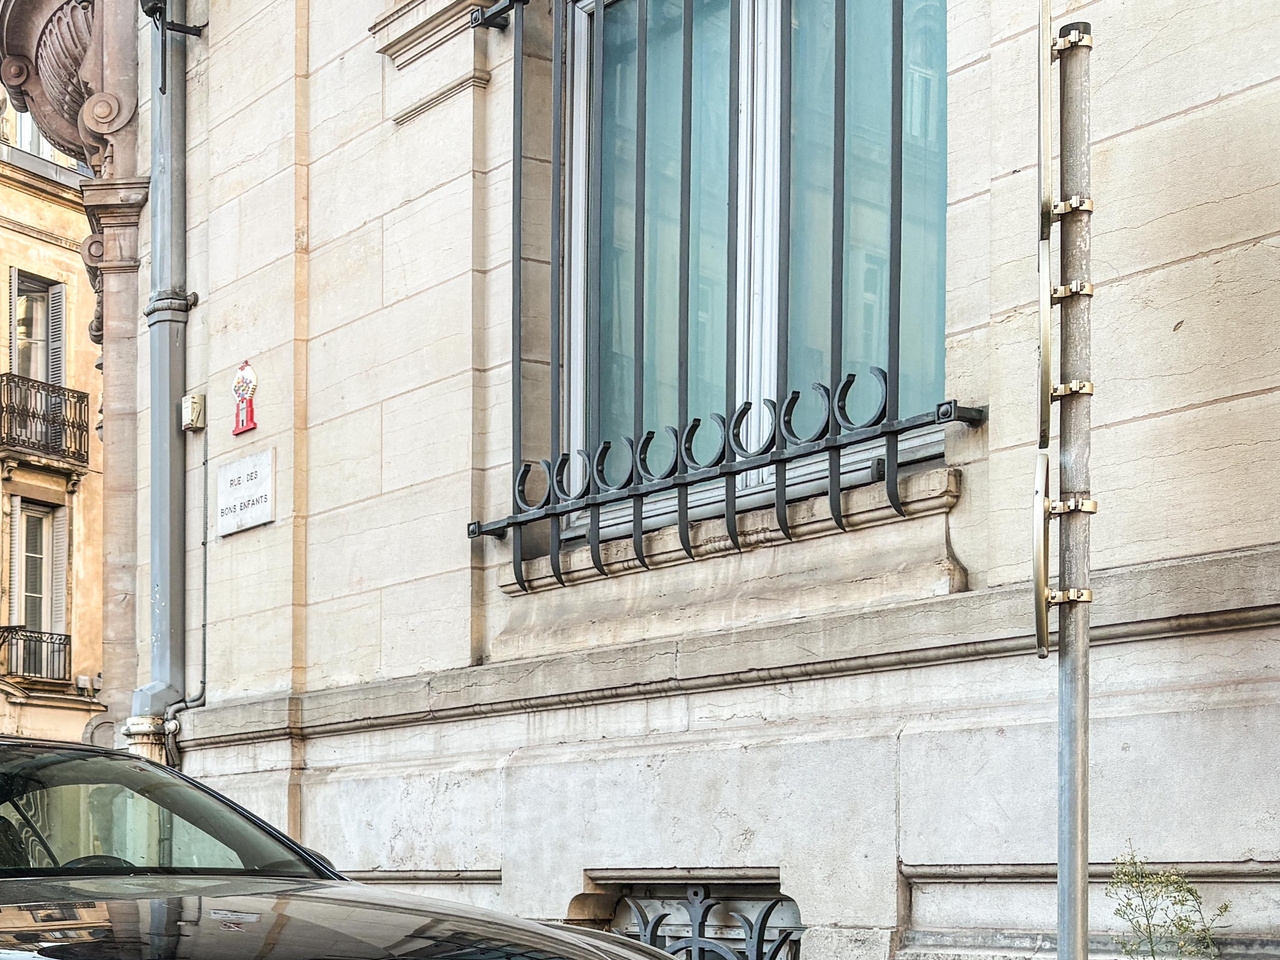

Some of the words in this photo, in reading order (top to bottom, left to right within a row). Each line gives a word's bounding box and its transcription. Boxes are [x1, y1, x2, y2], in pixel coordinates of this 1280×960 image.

[229, 476, 241, 488] RUE
[246, 470, 258, 483] DES
[220, 504, 236, 517] BONS
[239, 494, 268, 511] ENFANTS
